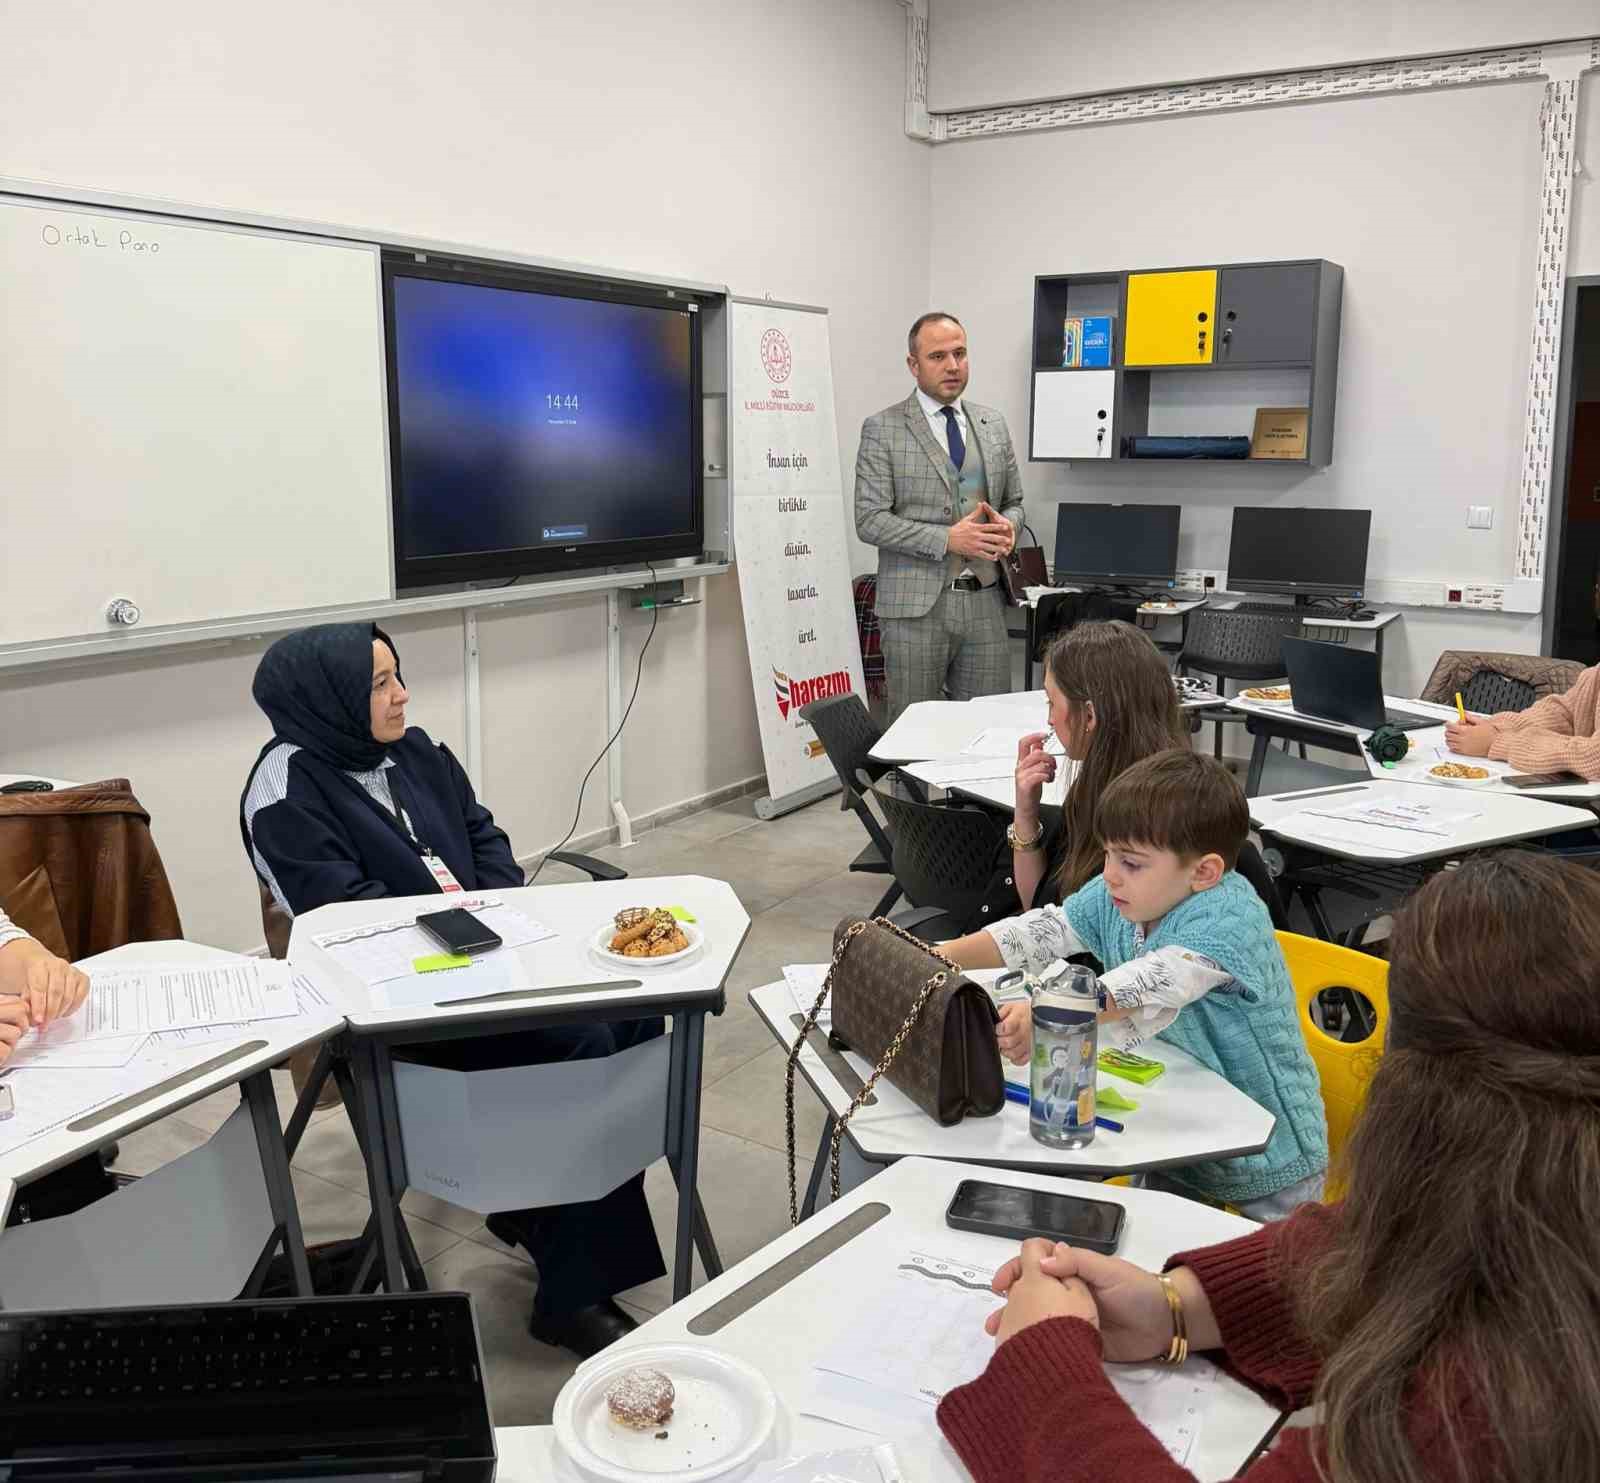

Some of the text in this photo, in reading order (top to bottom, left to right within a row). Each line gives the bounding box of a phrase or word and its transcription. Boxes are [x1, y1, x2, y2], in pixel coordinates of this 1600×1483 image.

[767, 448, 808, 471] İnsan için
[778, 497, 807, 513] birlikte
[784, 541, 812, 561] düşün.
[787, 584, 819, 601] tasarla.
[798, 627, 817, 644] üret.
